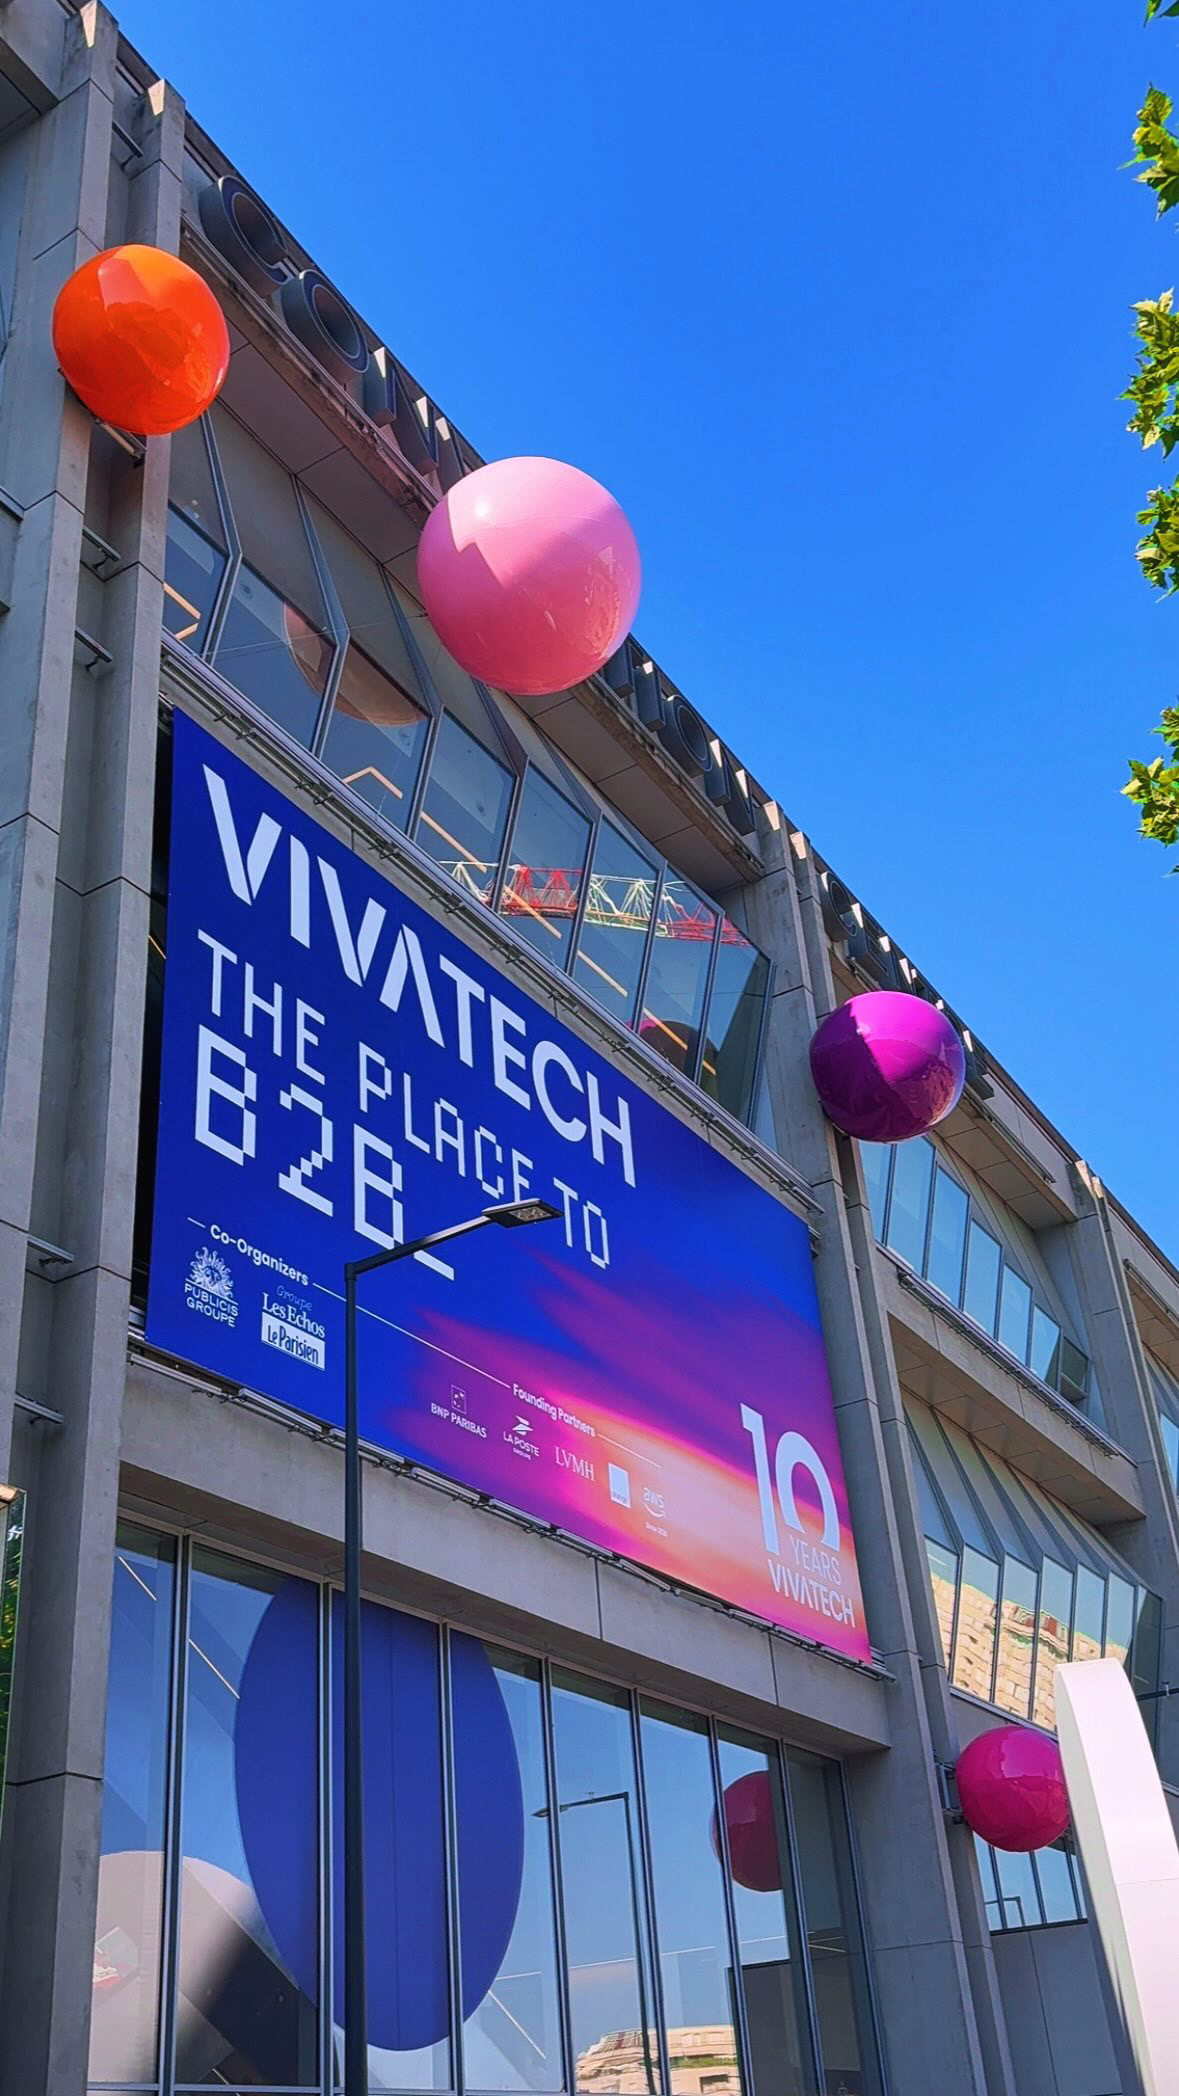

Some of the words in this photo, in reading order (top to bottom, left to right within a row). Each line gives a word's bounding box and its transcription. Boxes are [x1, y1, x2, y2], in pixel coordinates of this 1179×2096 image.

[202, 763, 635, 1189] VIVATECH
[197, 929, 325, 1085] THE
[358, 1041, 533, 1203] PLACE
[553, 1177, 610, 1269] TO
[210, 1224, 309, 1287] Co-Organizers
[184, 1282, 239, 1317] PUBLICIS
[186, 1297, 236, 1328] GROUPE
[276, 1285, 313, 1312] Groupe
[431, 1402, 450, 1420] BNP
[451, 1412, 487, 1438] PARIBAS
[513, 1383, 557, 1421] Founding
[558, 1407, 596, 1437] Partners
[503, 1431, 514, 1444] LA
[514, 1436, 540, 1457] POSTE
[555, 1446, 596, 1481] LVMH
[740, 1402, 840, 1556] 10
[789, 1534, 842, 1586] YEARS
[768, 1559, 856, 1629] VIVATECH
